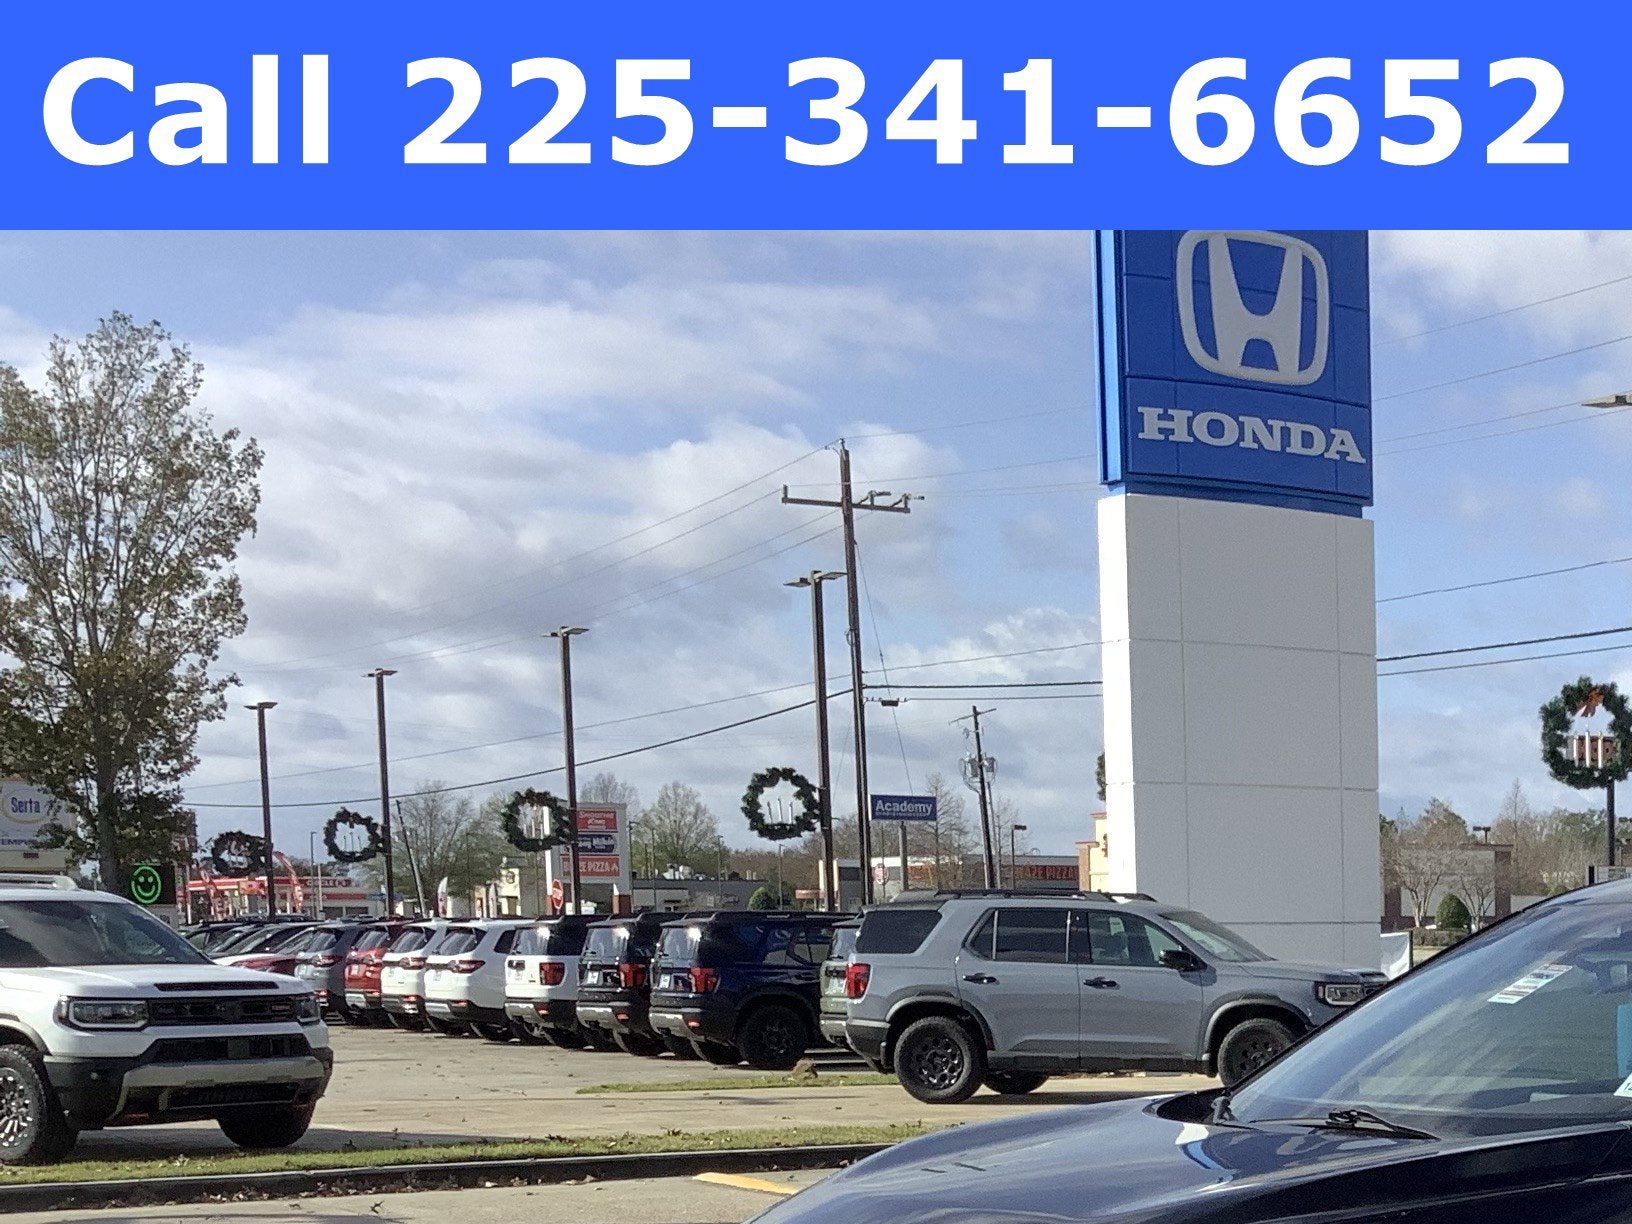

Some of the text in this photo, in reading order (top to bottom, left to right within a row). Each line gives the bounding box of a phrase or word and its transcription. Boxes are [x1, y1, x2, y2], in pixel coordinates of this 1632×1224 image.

[1137, 406, 1367, 464] HONDA
[11, 796, 40, 814] Serta
[875, 799, 933, 816] Academy
